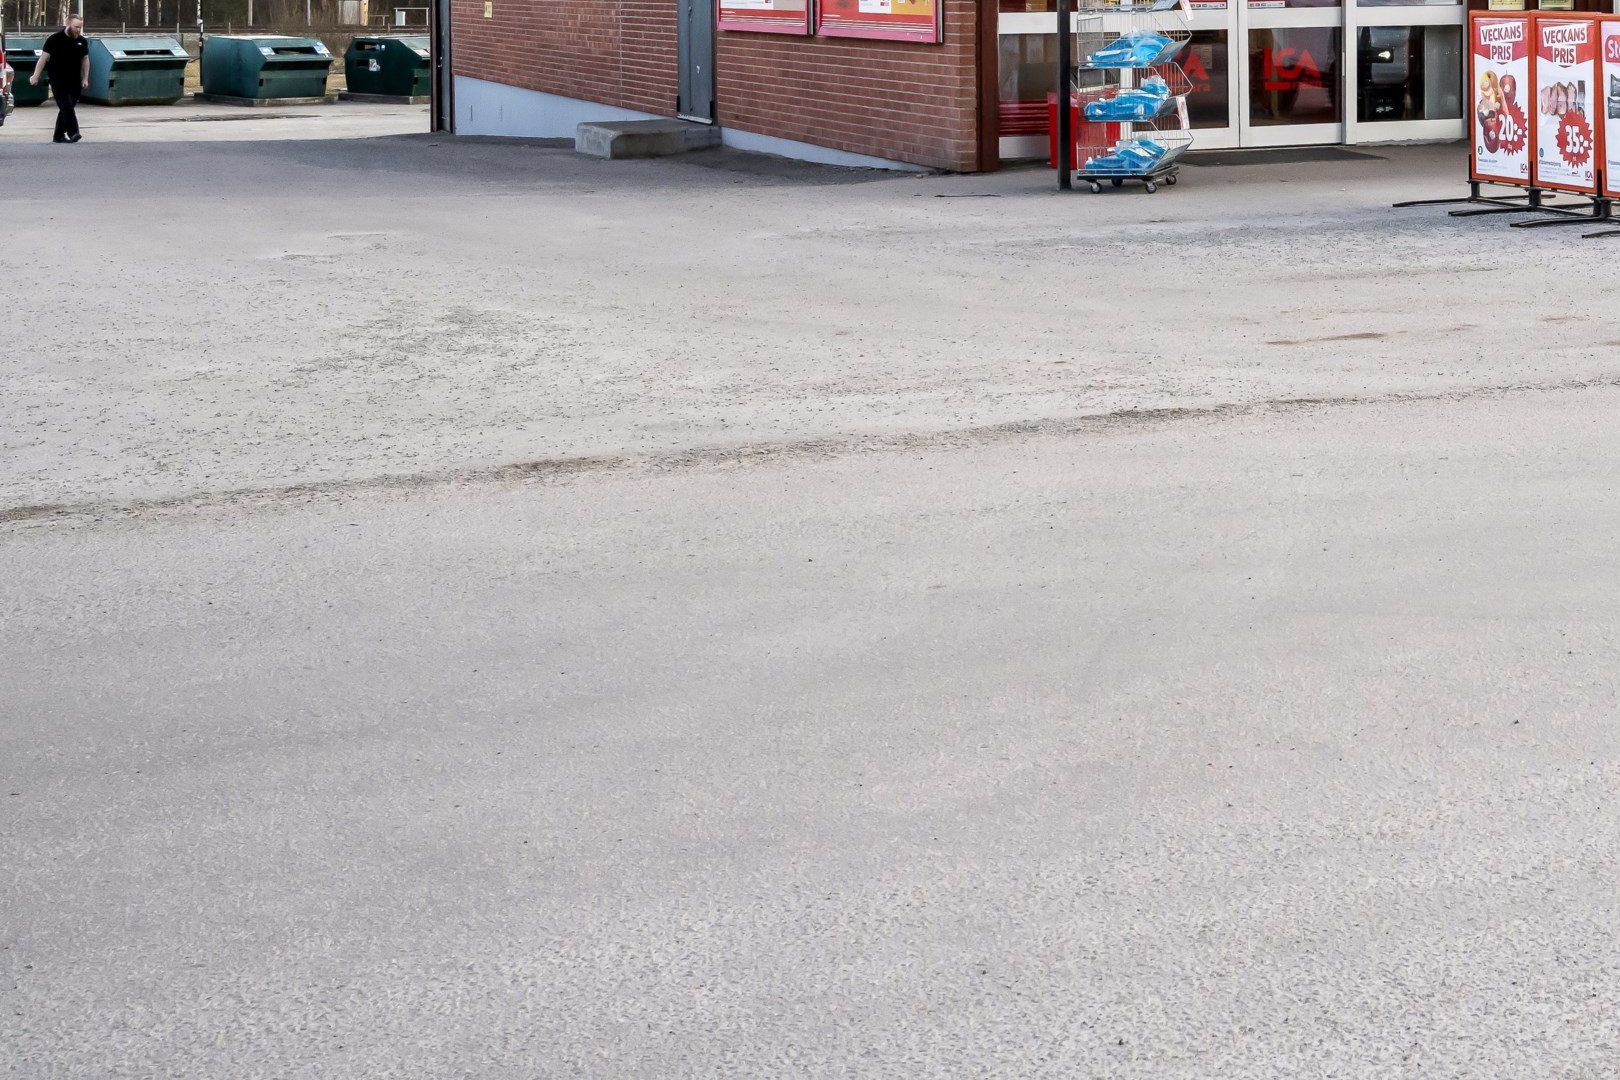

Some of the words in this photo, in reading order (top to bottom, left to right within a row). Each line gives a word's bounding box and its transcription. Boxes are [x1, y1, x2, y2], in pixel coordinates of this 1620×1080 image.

[1482, 25, 1521, 42] VECKANS
[1544, 27, 1586, 44] VECKANS
[1491, 45, 1511, 60] PRIS
[1554, 47, 1575, 64] PRIS
[1264, 48, 1321, 79] ICA
[1498, 114, 1523, 142] 20:-
[1565, 125, 1589, 154] 35:-
